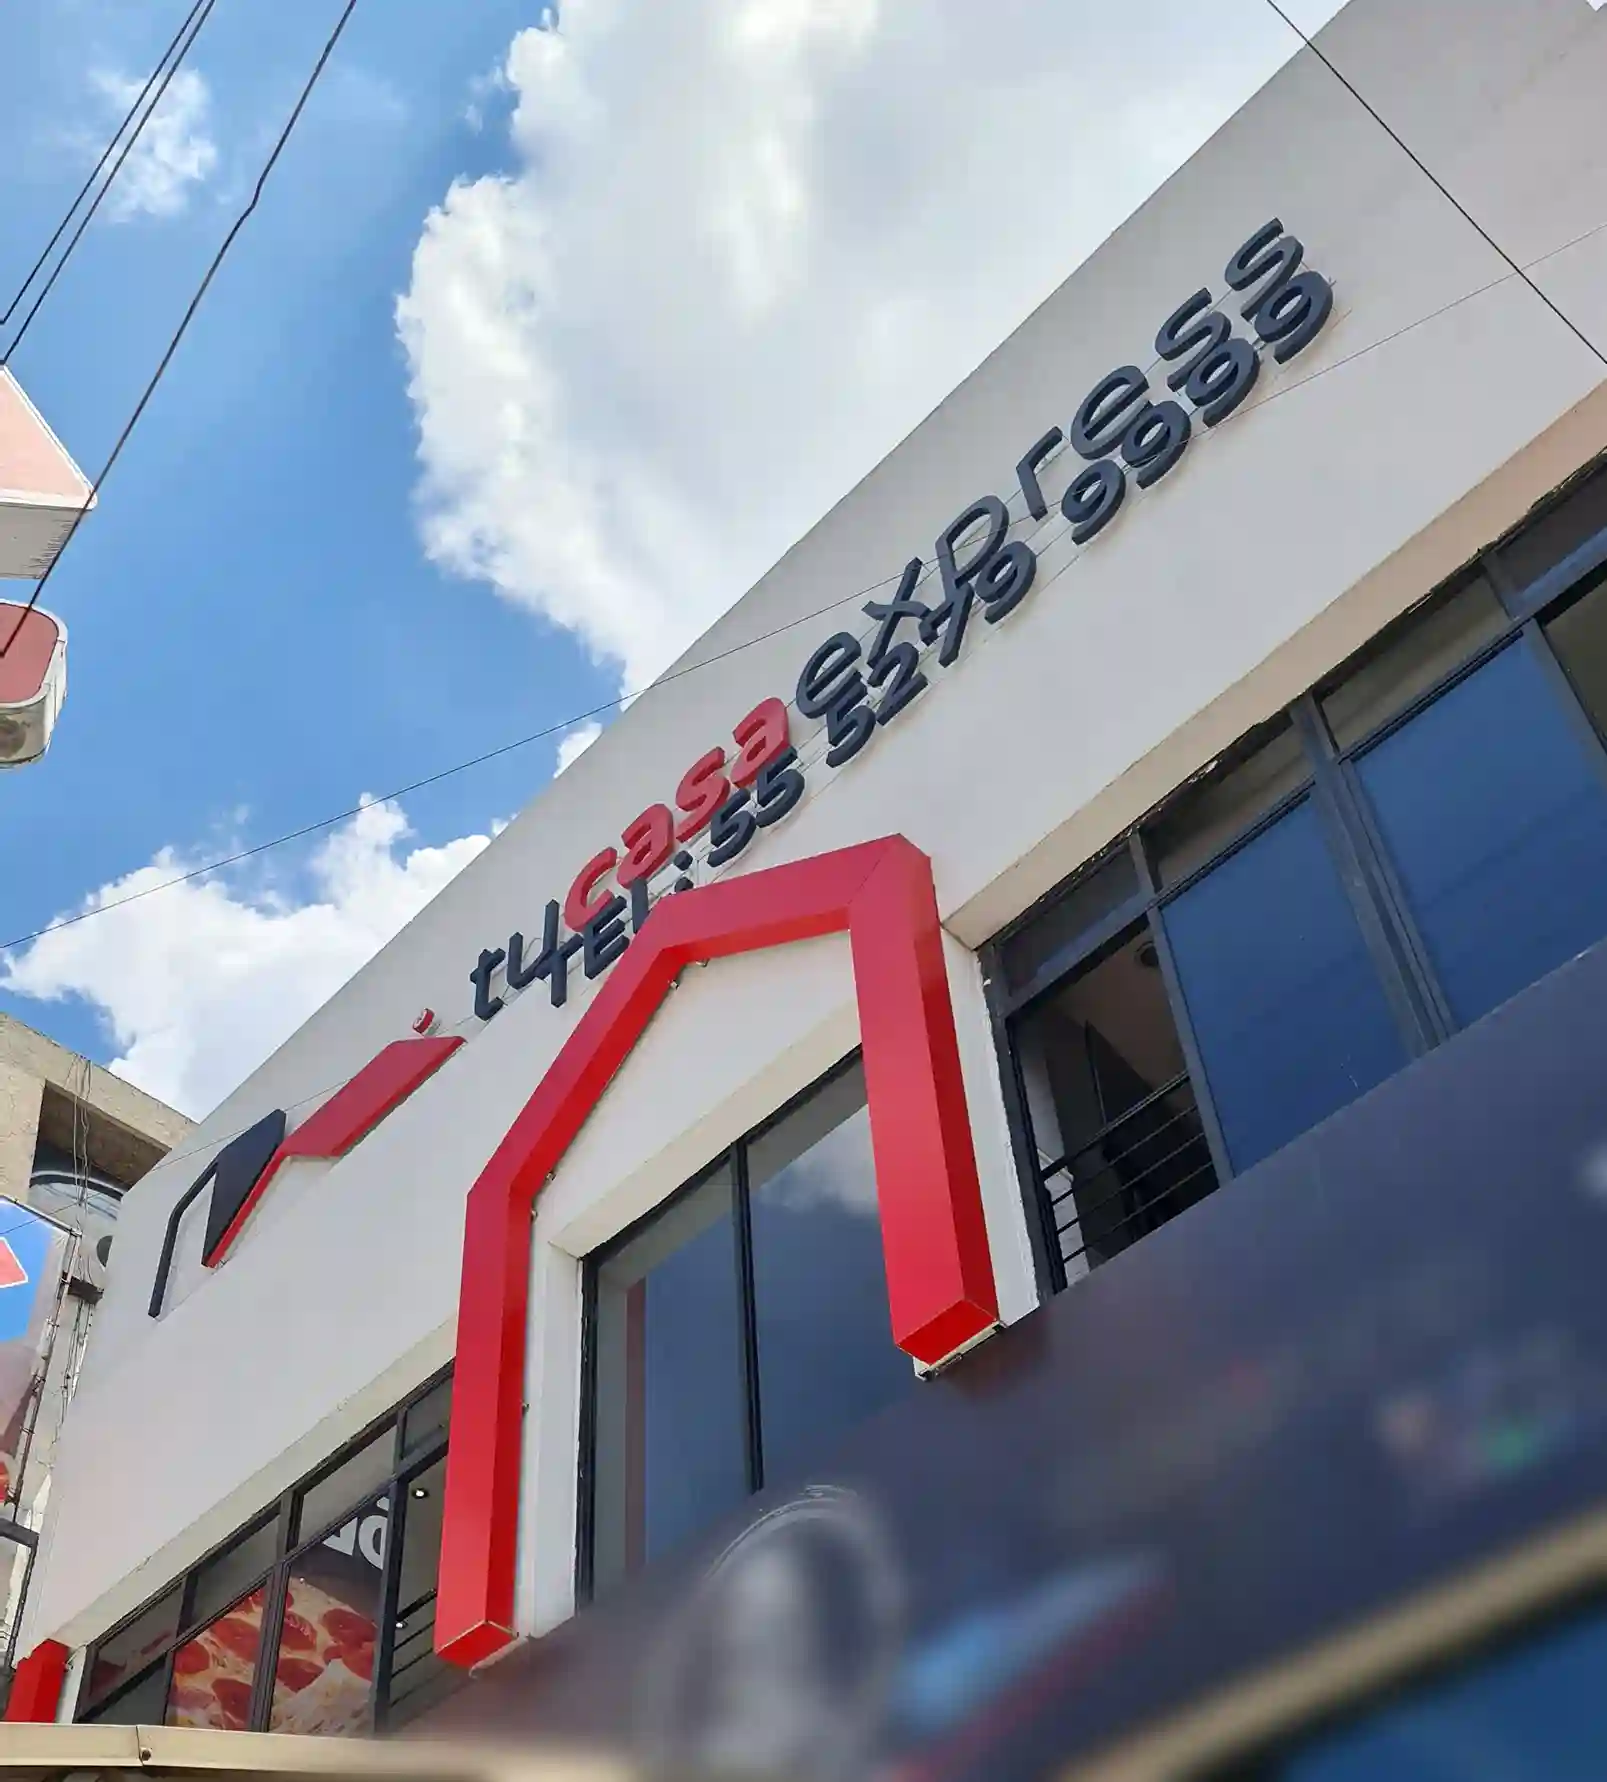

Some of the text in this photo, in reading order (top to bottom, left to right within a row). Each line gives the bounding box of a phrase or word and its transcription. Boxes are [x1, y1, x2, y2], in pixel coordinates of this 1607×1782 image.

[470, 217, 1305, 1021] tu casa express
[706, 745, 805, 868] 55
[825, 540, 1037, 768] 5279
[1060, 270, 1334, 546] 9999
